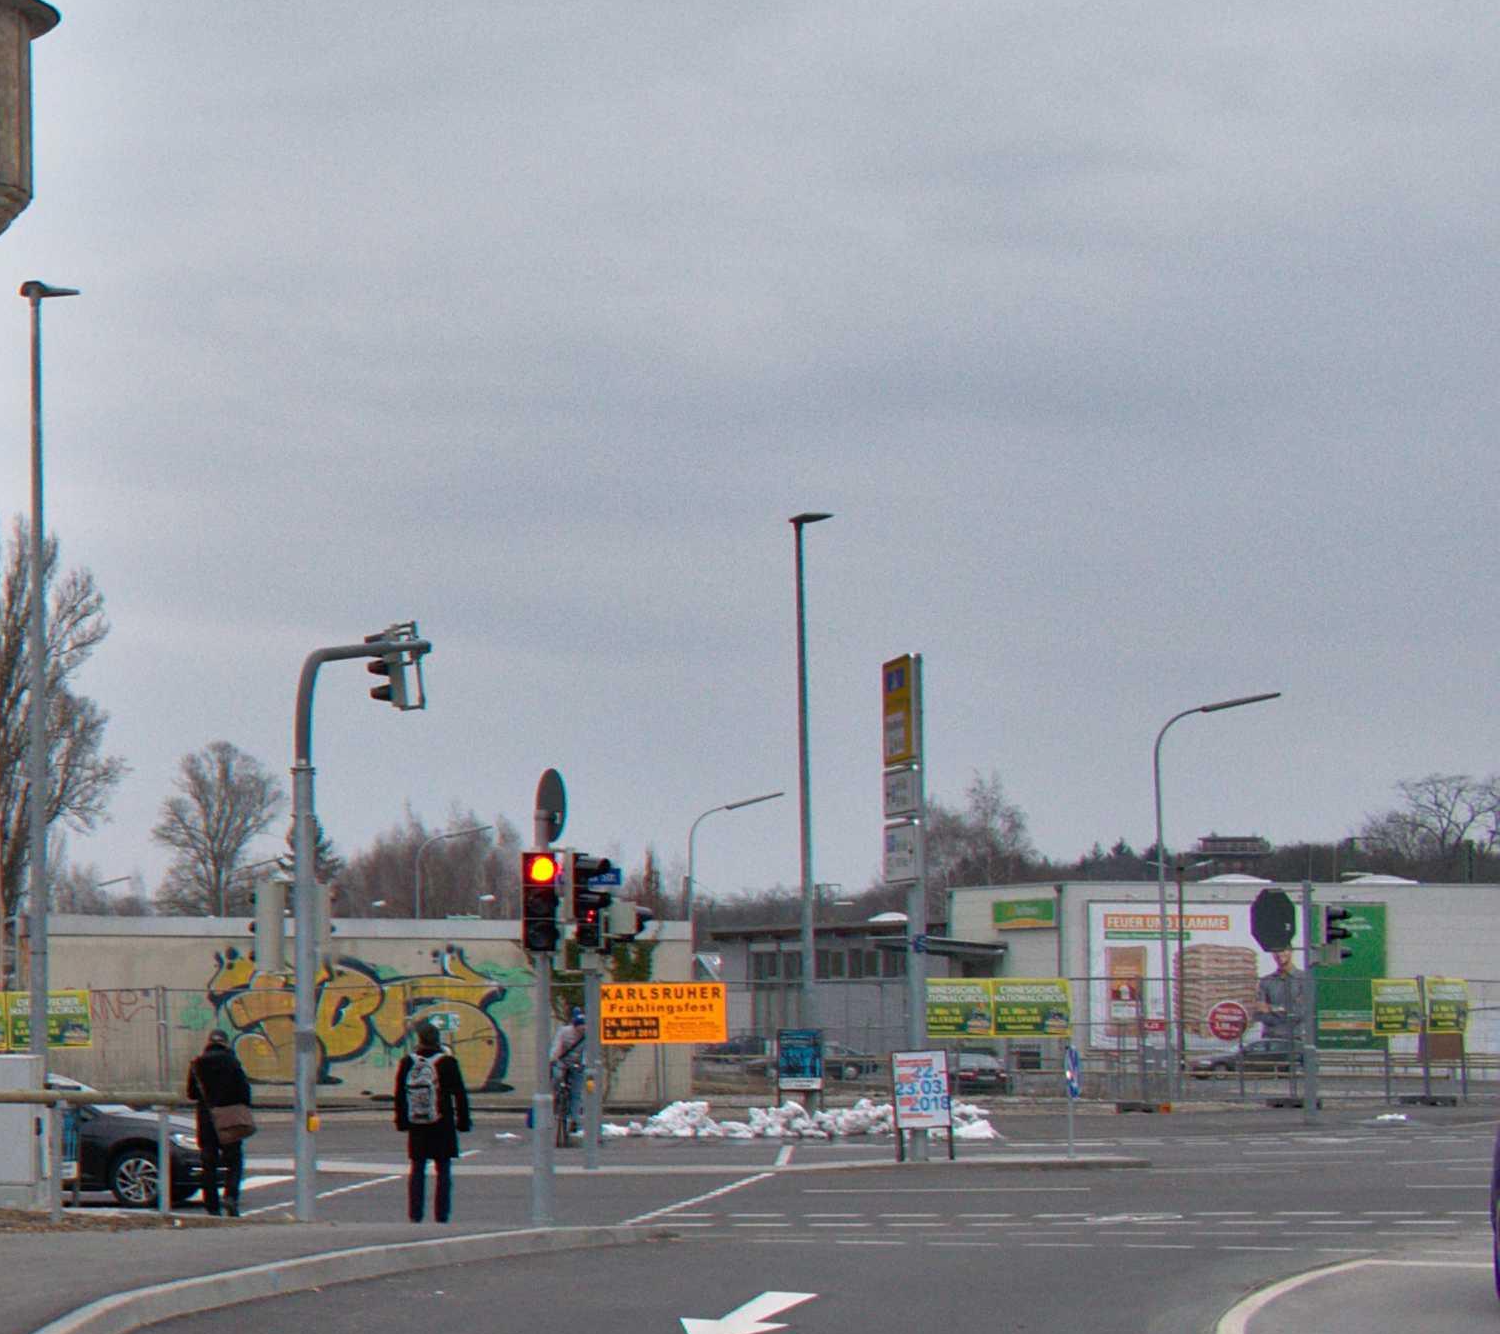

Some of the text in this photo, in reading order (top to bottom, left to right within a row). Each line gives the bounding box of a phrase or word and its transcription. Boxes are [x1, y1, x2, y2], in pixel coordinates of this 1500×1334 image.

[1107, 916, 1141, 927] FEUER
[601, 987, 722, 999] KARLSRUHER
[609, 1002, 714, 1014] Frühlingsfest
[913, 1067, 939, 1079] 22.
[895, 1079, 946, 1096] 23.03.
[909, 1095, 952, 1111] 2018
